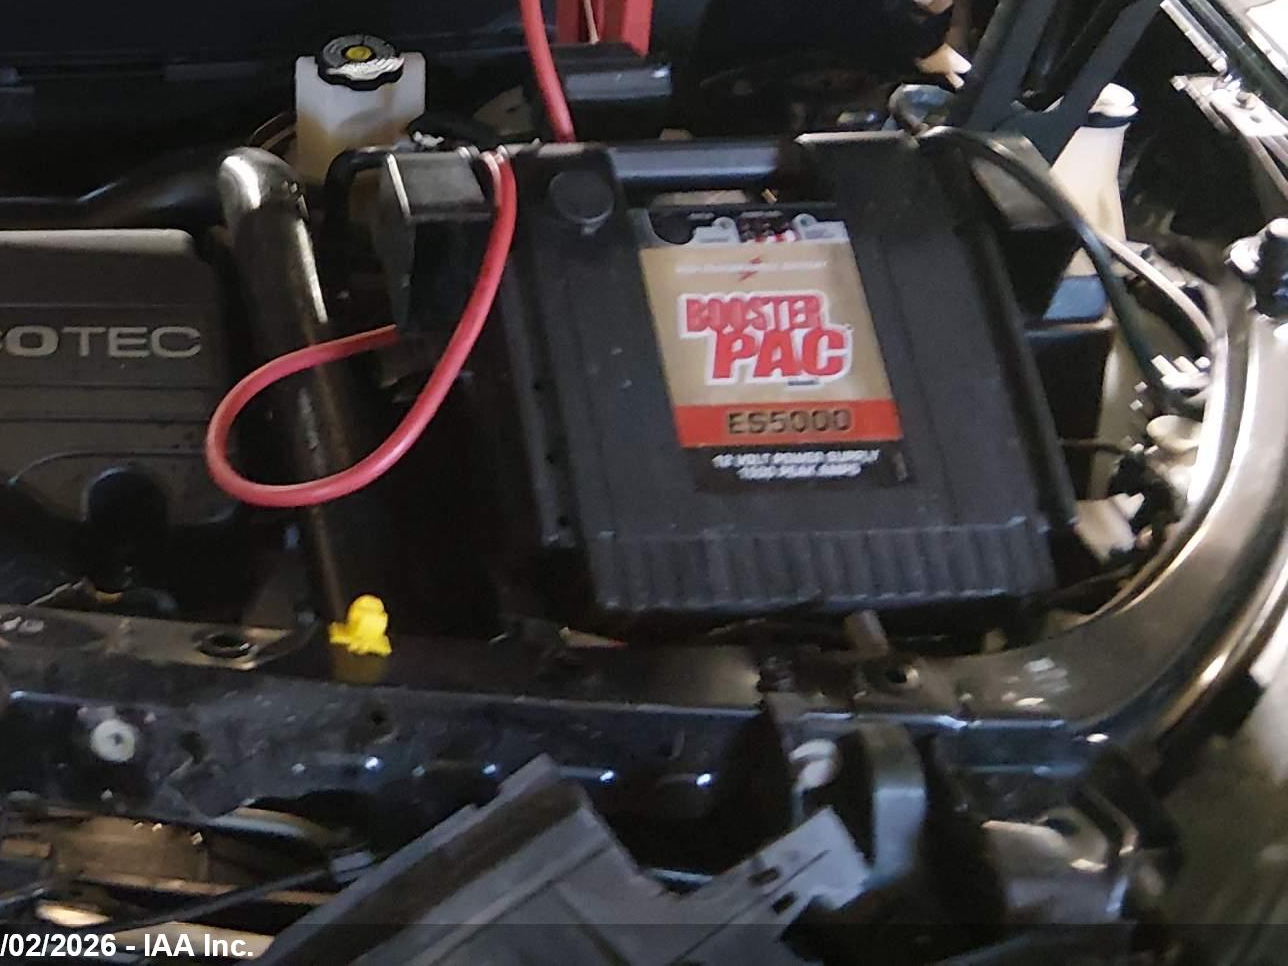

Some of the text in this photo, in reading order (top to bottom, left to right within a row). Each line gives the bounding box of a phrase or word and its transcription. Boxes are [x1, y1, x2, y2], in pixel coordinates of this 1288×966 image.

[685, 295, 824, 333] BOOSTER
[712, 327, 848, 380] PAC
[727, 408, 852, 435] ES5000
